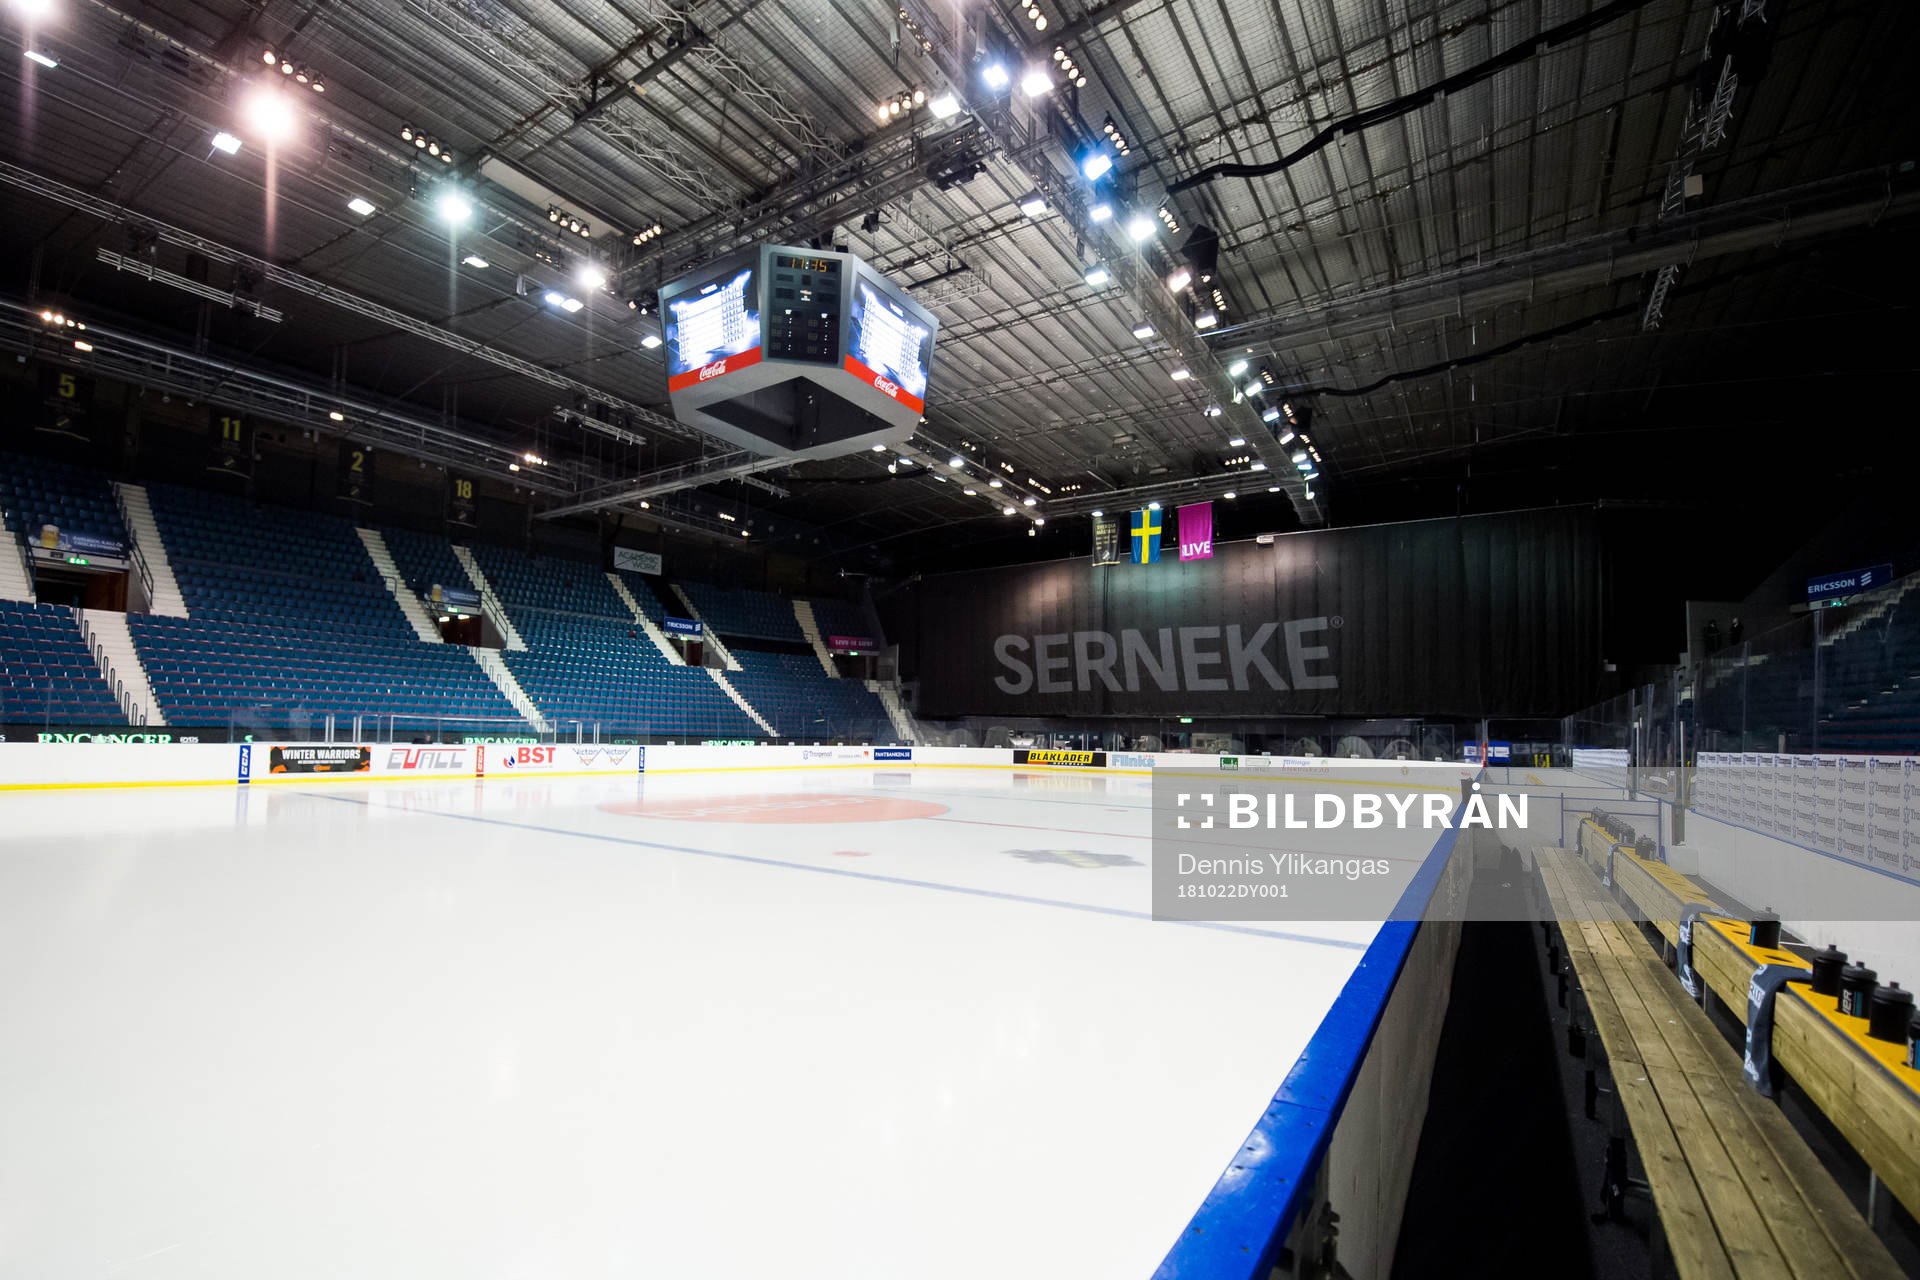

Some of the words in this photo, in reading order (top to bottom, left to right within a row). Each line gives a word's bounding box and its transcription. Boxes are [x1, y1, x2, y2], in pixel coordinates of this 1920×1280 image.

[58, 372, 76, 399] 5
[220, 416, 241, 442] 11
[351, 450, 365, 473] 2
[455, 479, 473, 499] 18
[1184, 541, 1211, 556] LIVE
[1808, 578, 1855, 593] ERICSSON
[993, 616, 1339, 695] SERNEKE
[240, 748, 249, 775] CCM
[282, 749, 315, 760] WINTER
[317, 749, 361, 759] WARRIORS
[518, 747, 556, 764] BST
[1029, 751, 1091, 763] BLÅKLÄDER
